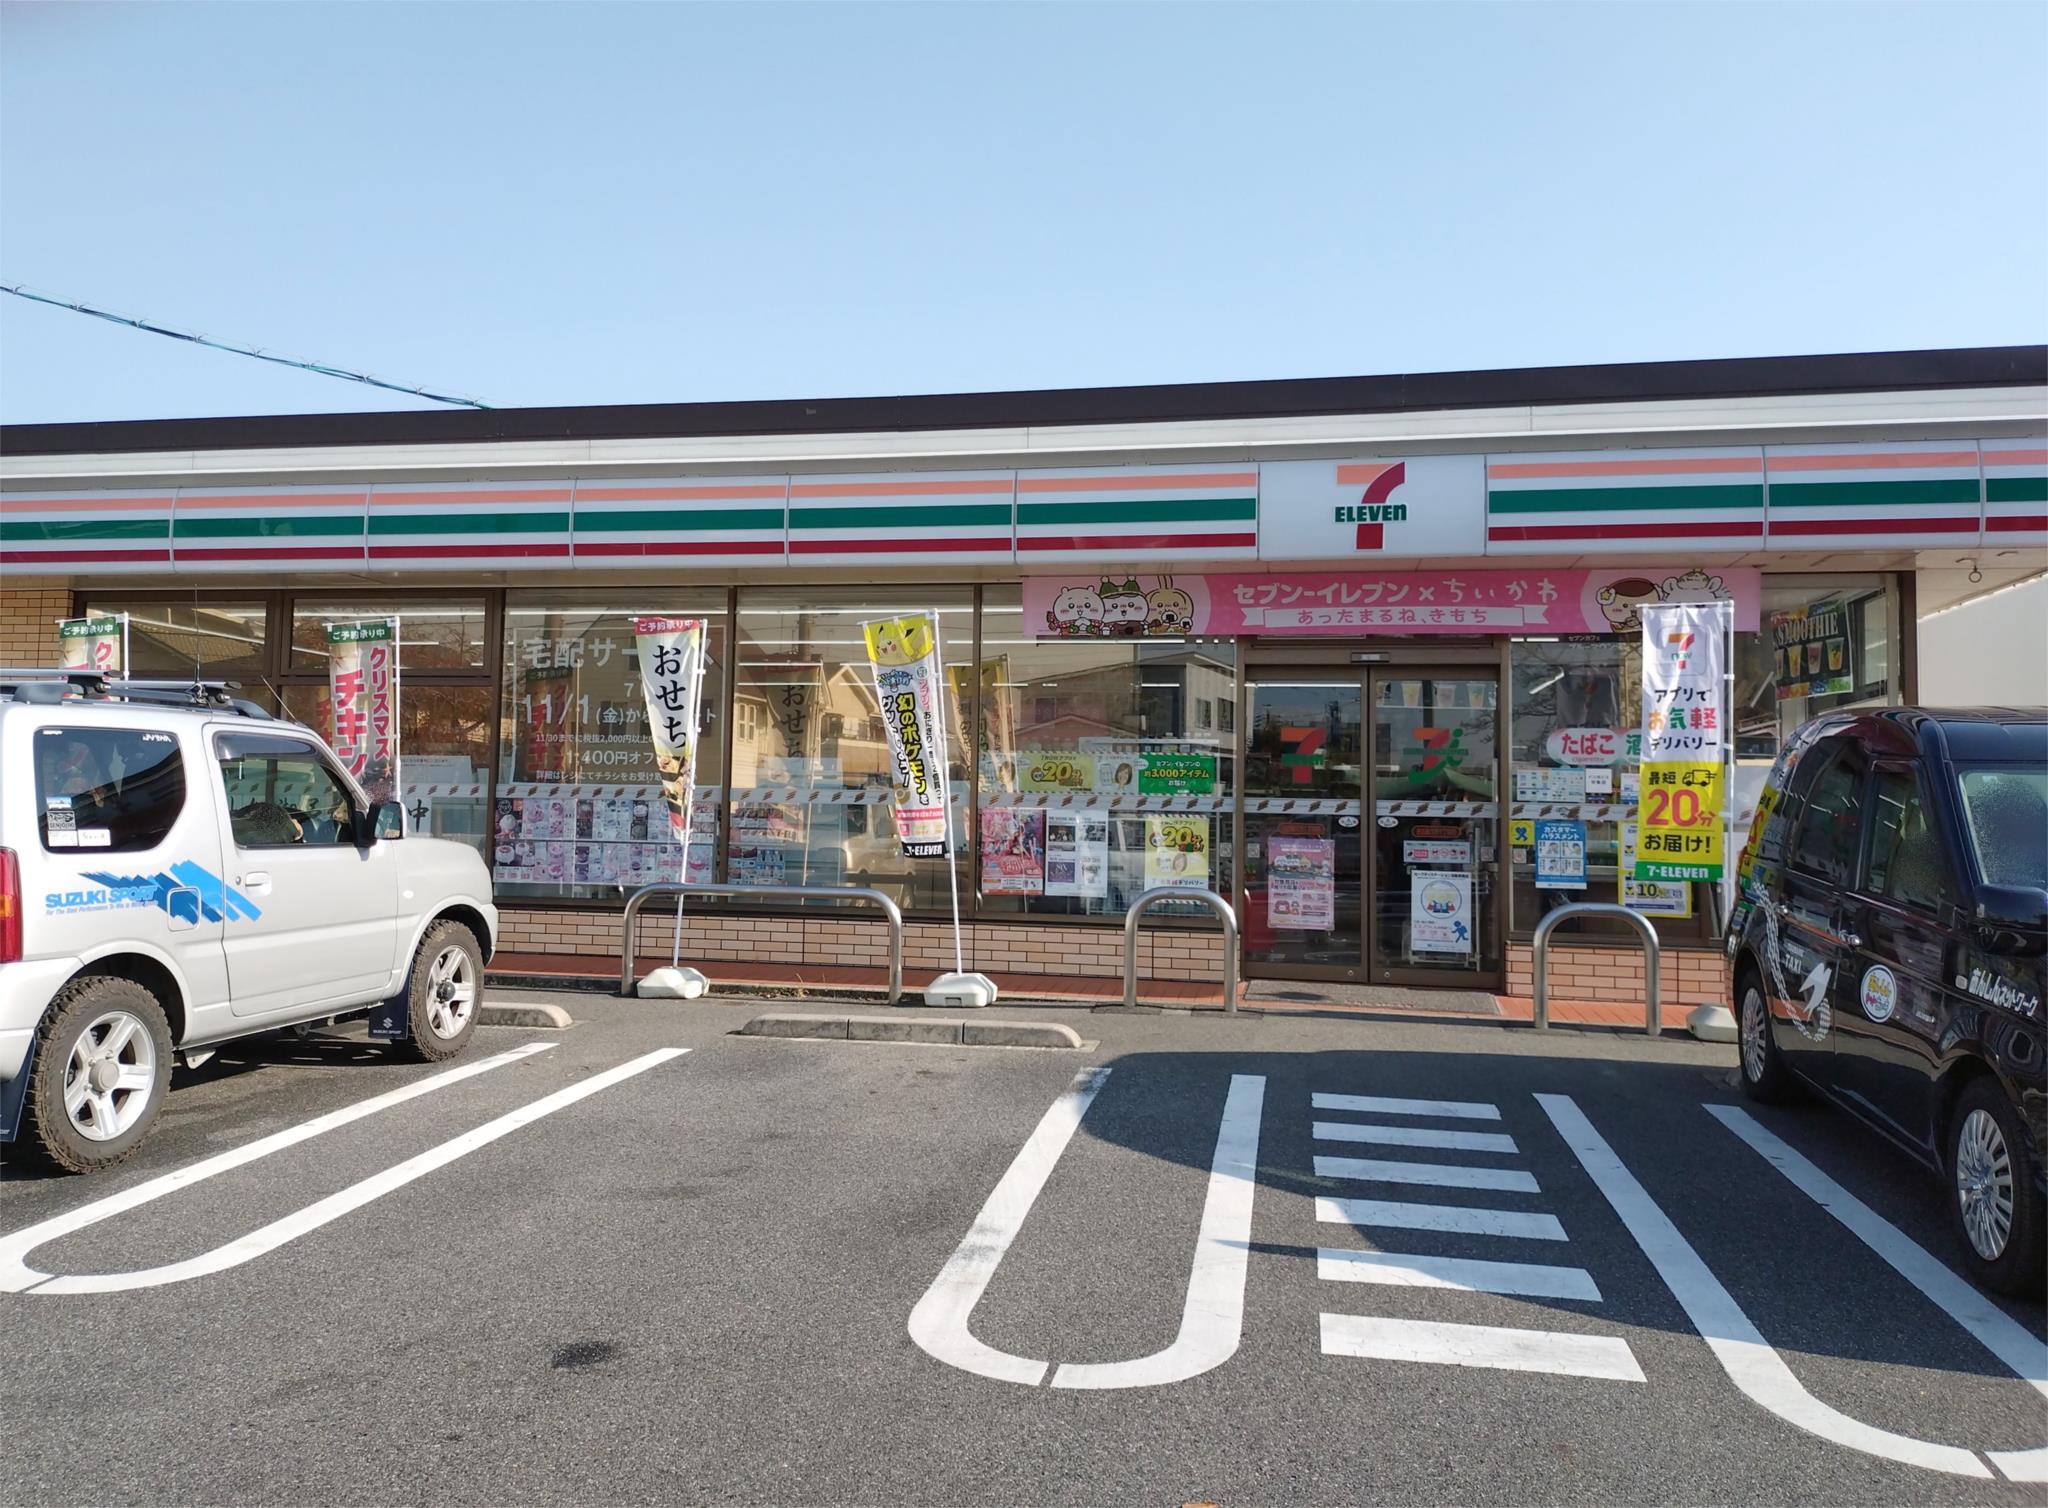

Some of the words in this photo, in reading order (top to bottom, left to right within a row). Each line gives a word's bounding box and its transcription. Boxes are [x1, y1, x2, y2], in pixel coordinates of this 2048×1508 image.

[1335, 504, 1407, 522] ELEVEn
[1337, 461, 1405, 549] 7
[1774, 612, 1839, 647] SMOOTHIE
[370, 646, 390, 762] クリスマス
[652, 644, 687, 749] おせち
[335, 668, 368, 777] チキン
[1648, 707, 1717, 730] お気軽
[1561, 734, 1616, 755] たばこ
[1651, 736, 1718, 750] デリバリー
[1648, 772, 1677, 785] 最短
[1647, 788, 1716, 827] 20分
[1644, 834, 1711, 853] お届け!
[1647, 866, 1709, 878] 7-ELEVEn
[45, 889, 106, 908] SUZUKI
[109, 886, 159, 901] SPORT
[1785, 953, 1802, 976] TAXI
